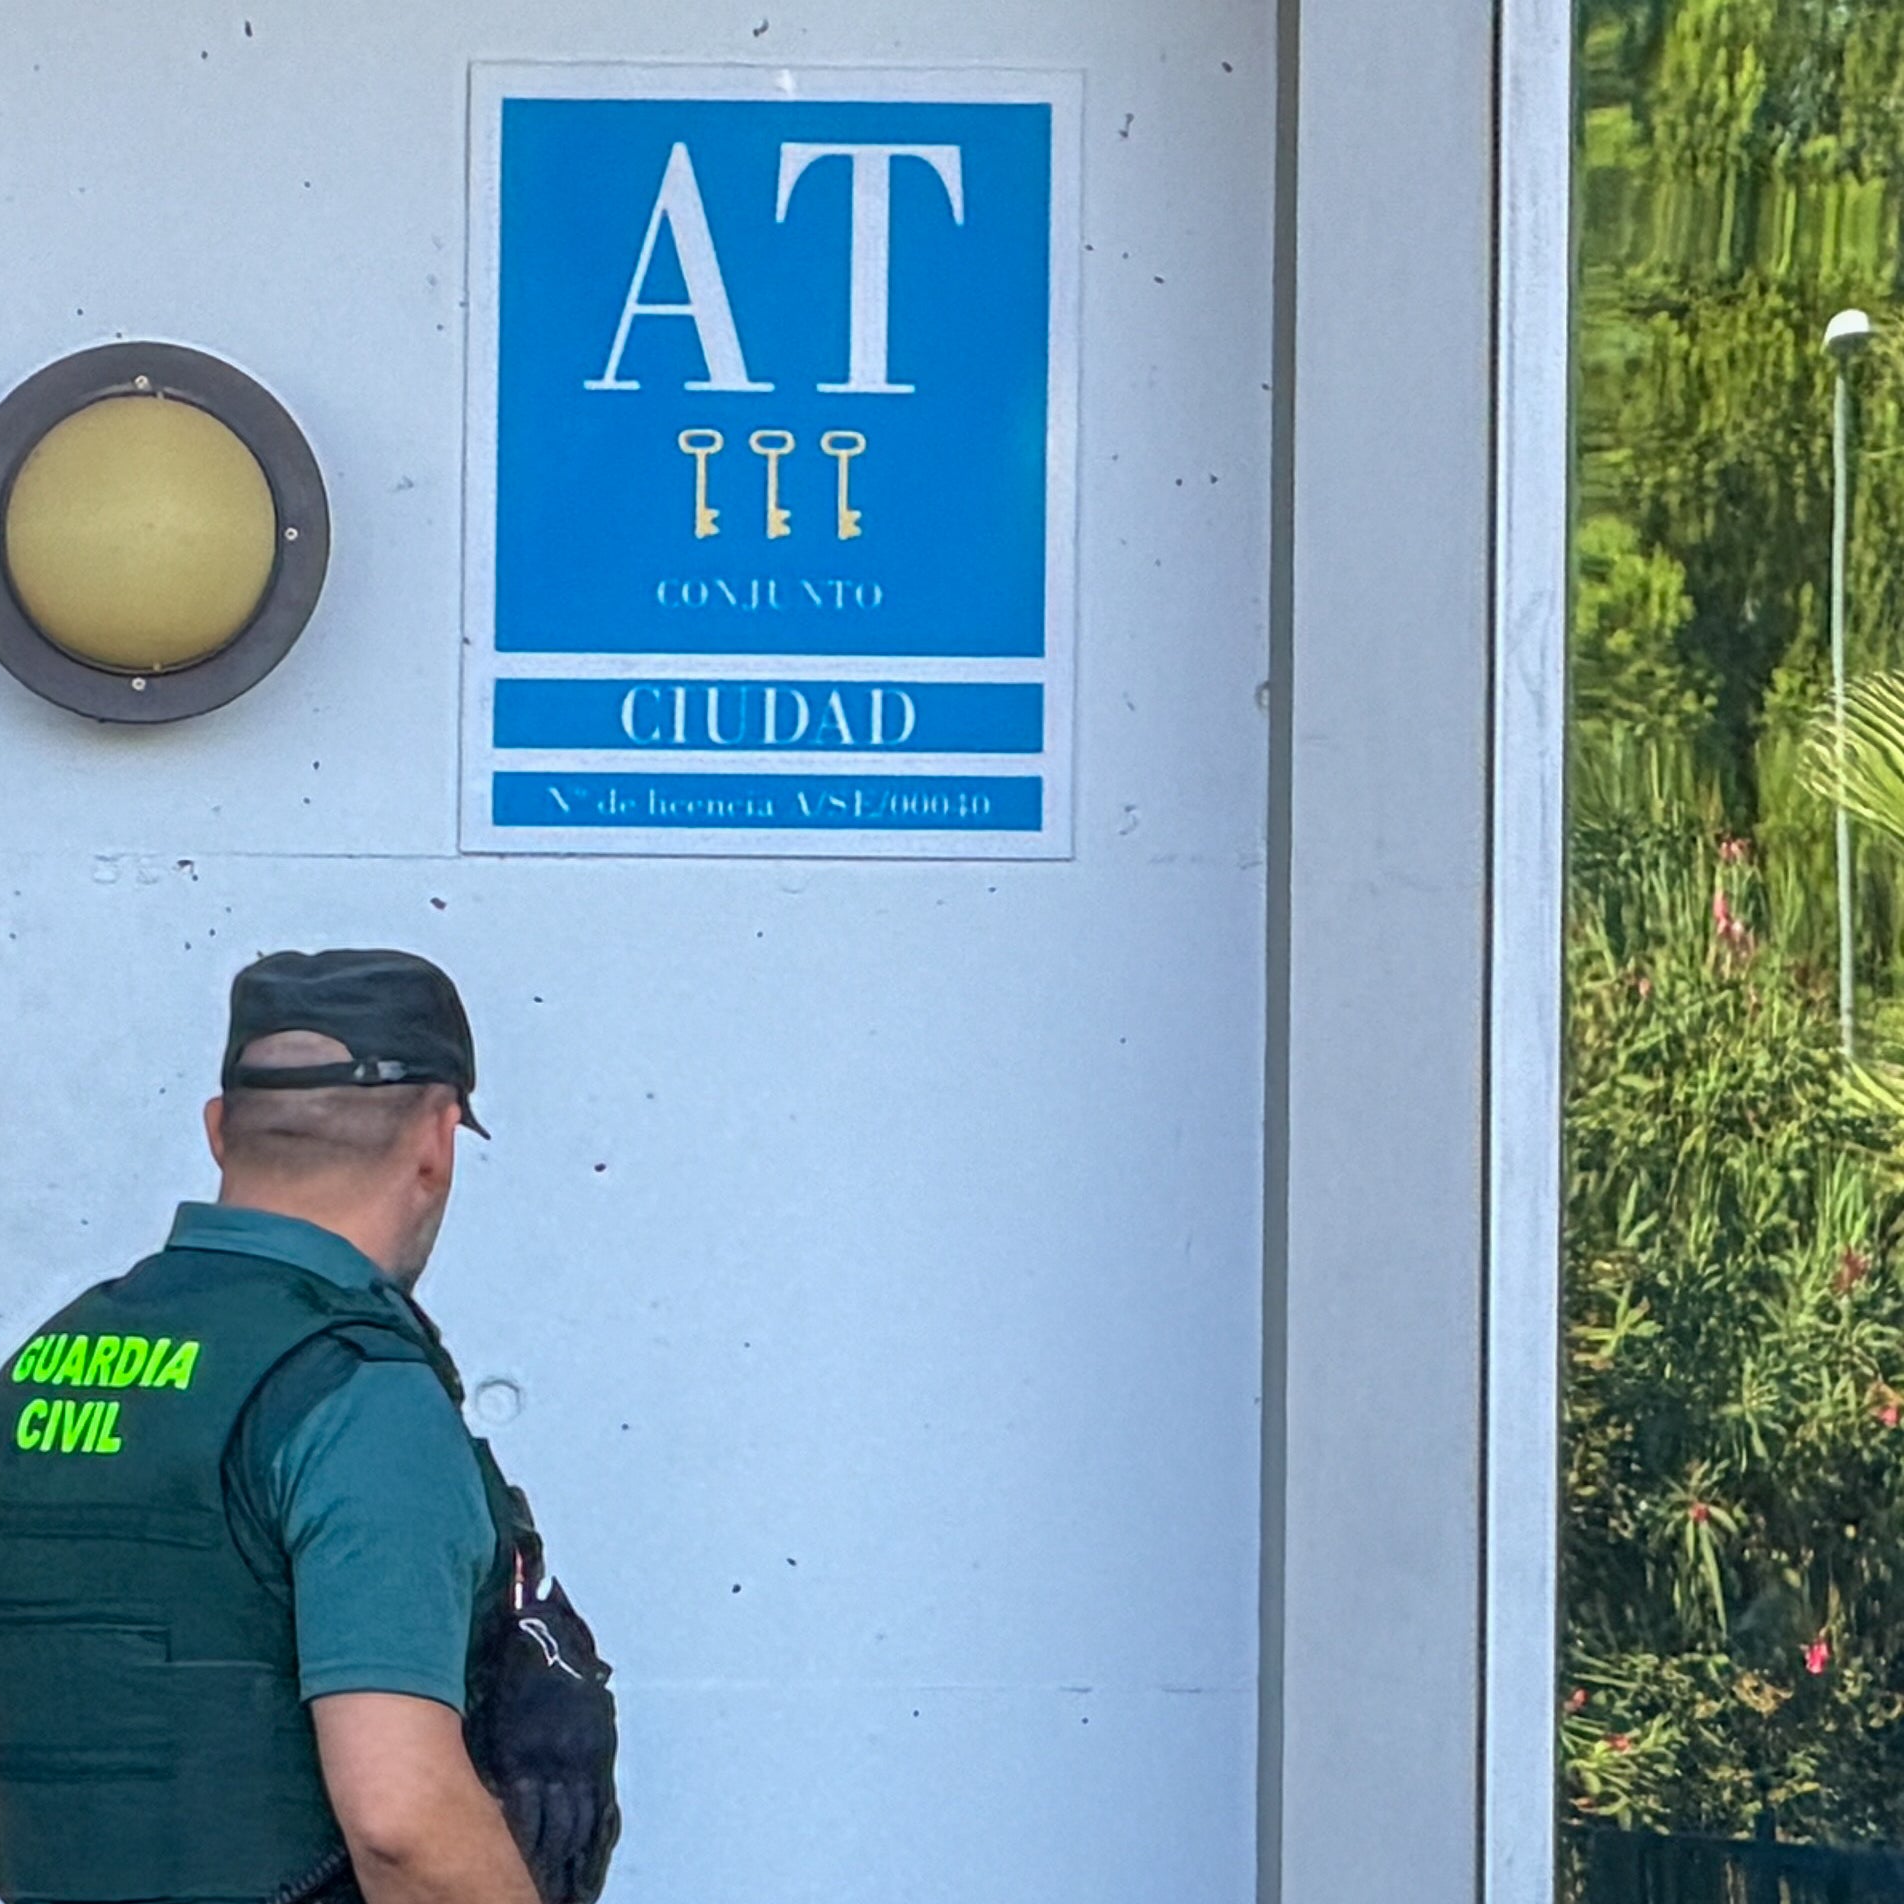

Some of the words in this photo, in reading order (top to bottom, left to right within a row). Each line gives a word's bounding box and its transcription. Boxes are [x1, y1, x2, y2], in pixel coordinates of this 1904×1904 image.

[583, 141, 965, 394] AT
[656, 579, 883, 610] CONJUNTO
[621, 685, 916, 745] CIUDAD
[597, 786, 637, 815] de
[649, 787, 774, 817] licencia
[11, 1332, 201, 1391] GUARDIA
[15, 1398, 124, 1455] CIVIL
